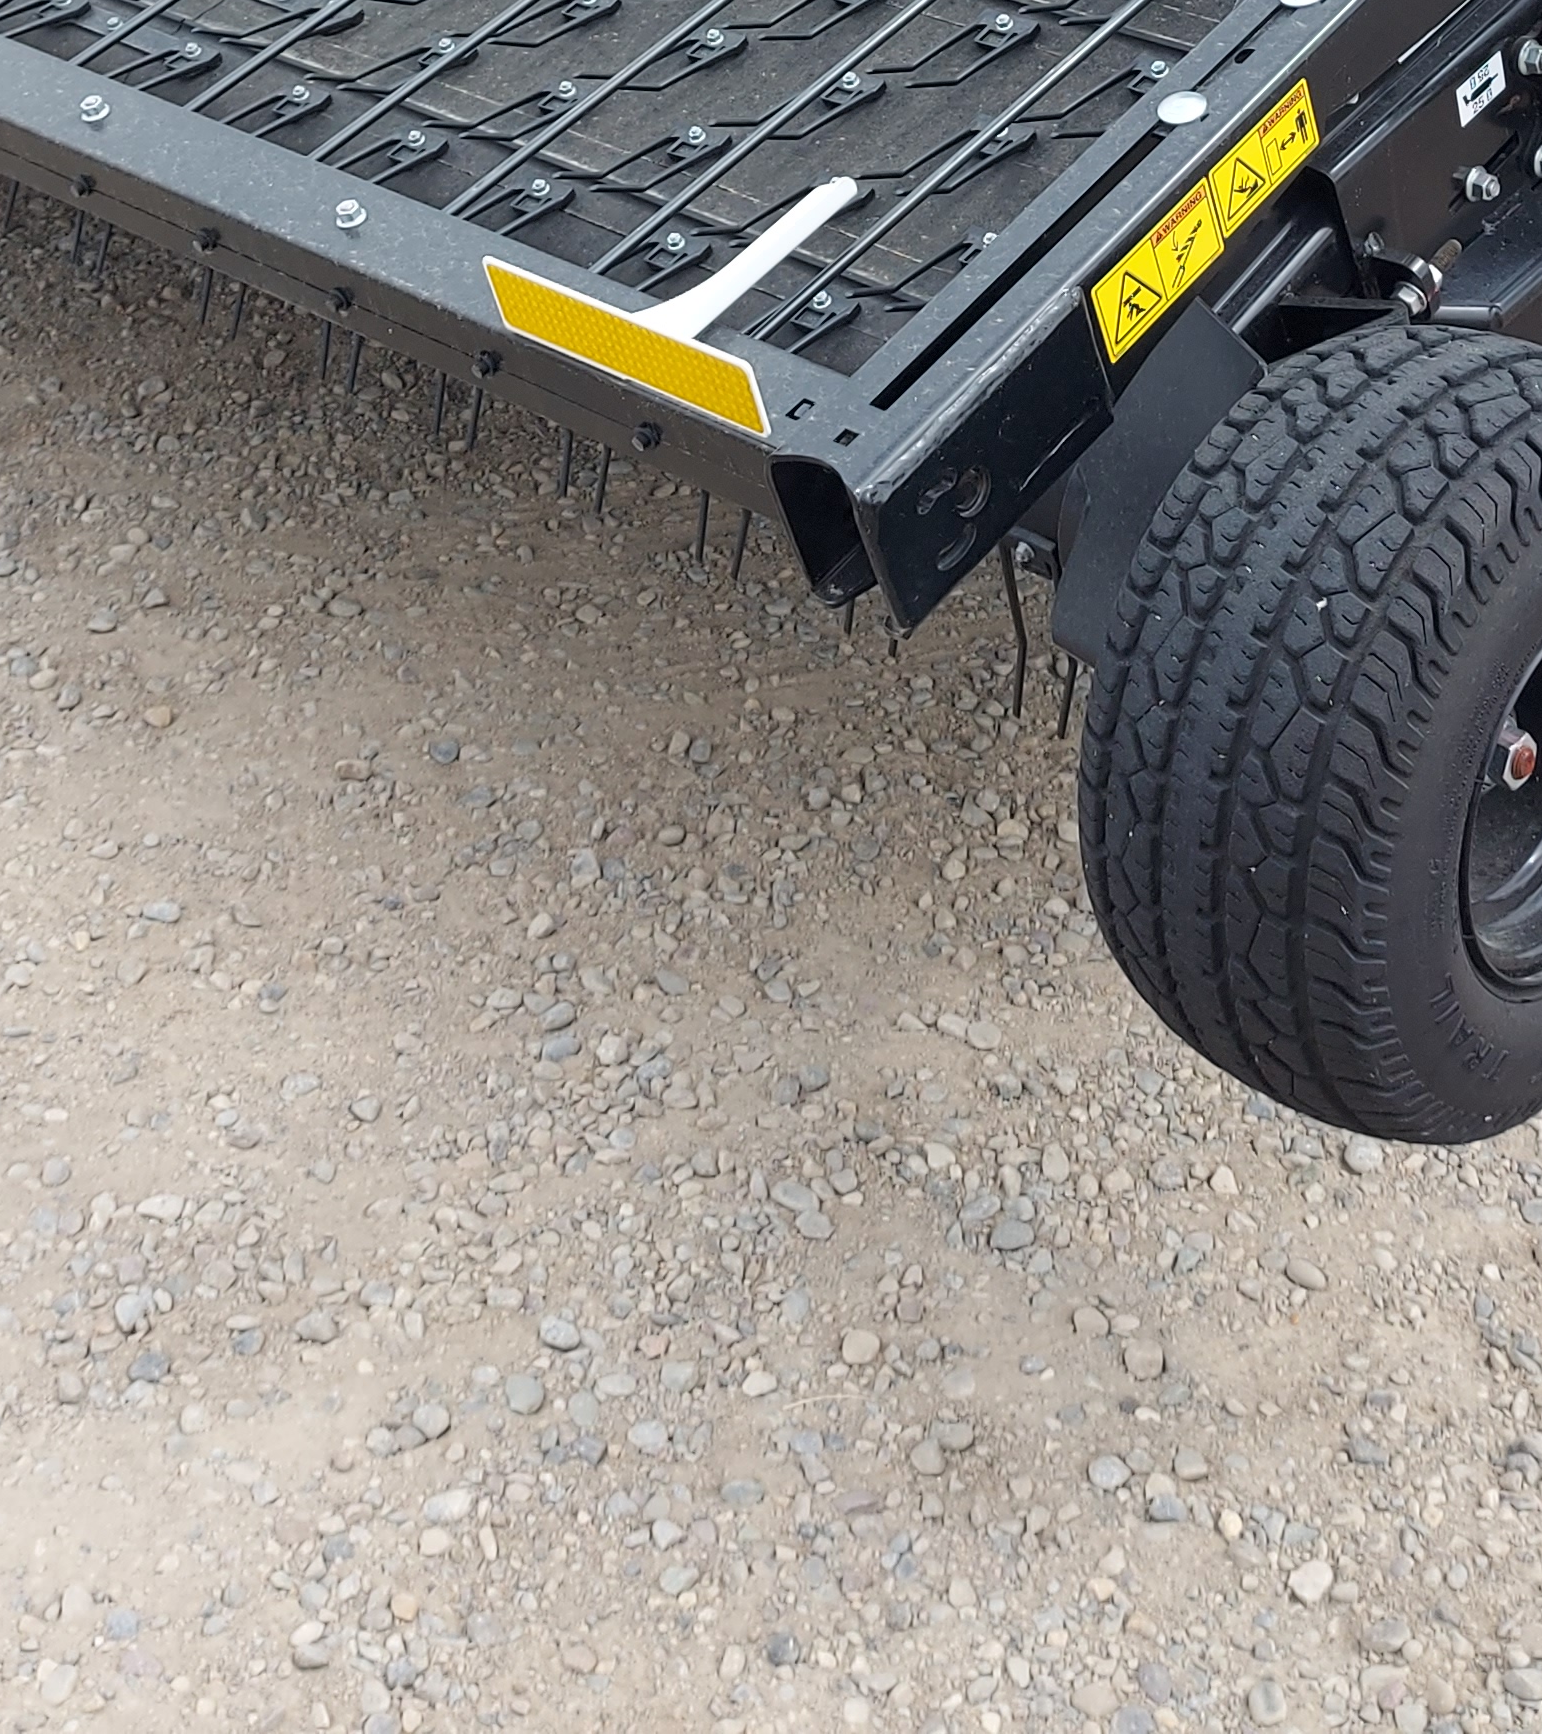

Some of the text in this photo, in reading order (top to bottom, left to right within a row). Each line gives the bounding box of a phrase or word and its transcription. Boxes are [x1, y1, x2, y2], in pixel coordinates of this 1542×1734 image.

[1268, 88, 1304, 126] WARNING
[1161, 190, 1203, 234] WARNING
[1429, 972, 1508, 1081] TRAIL
